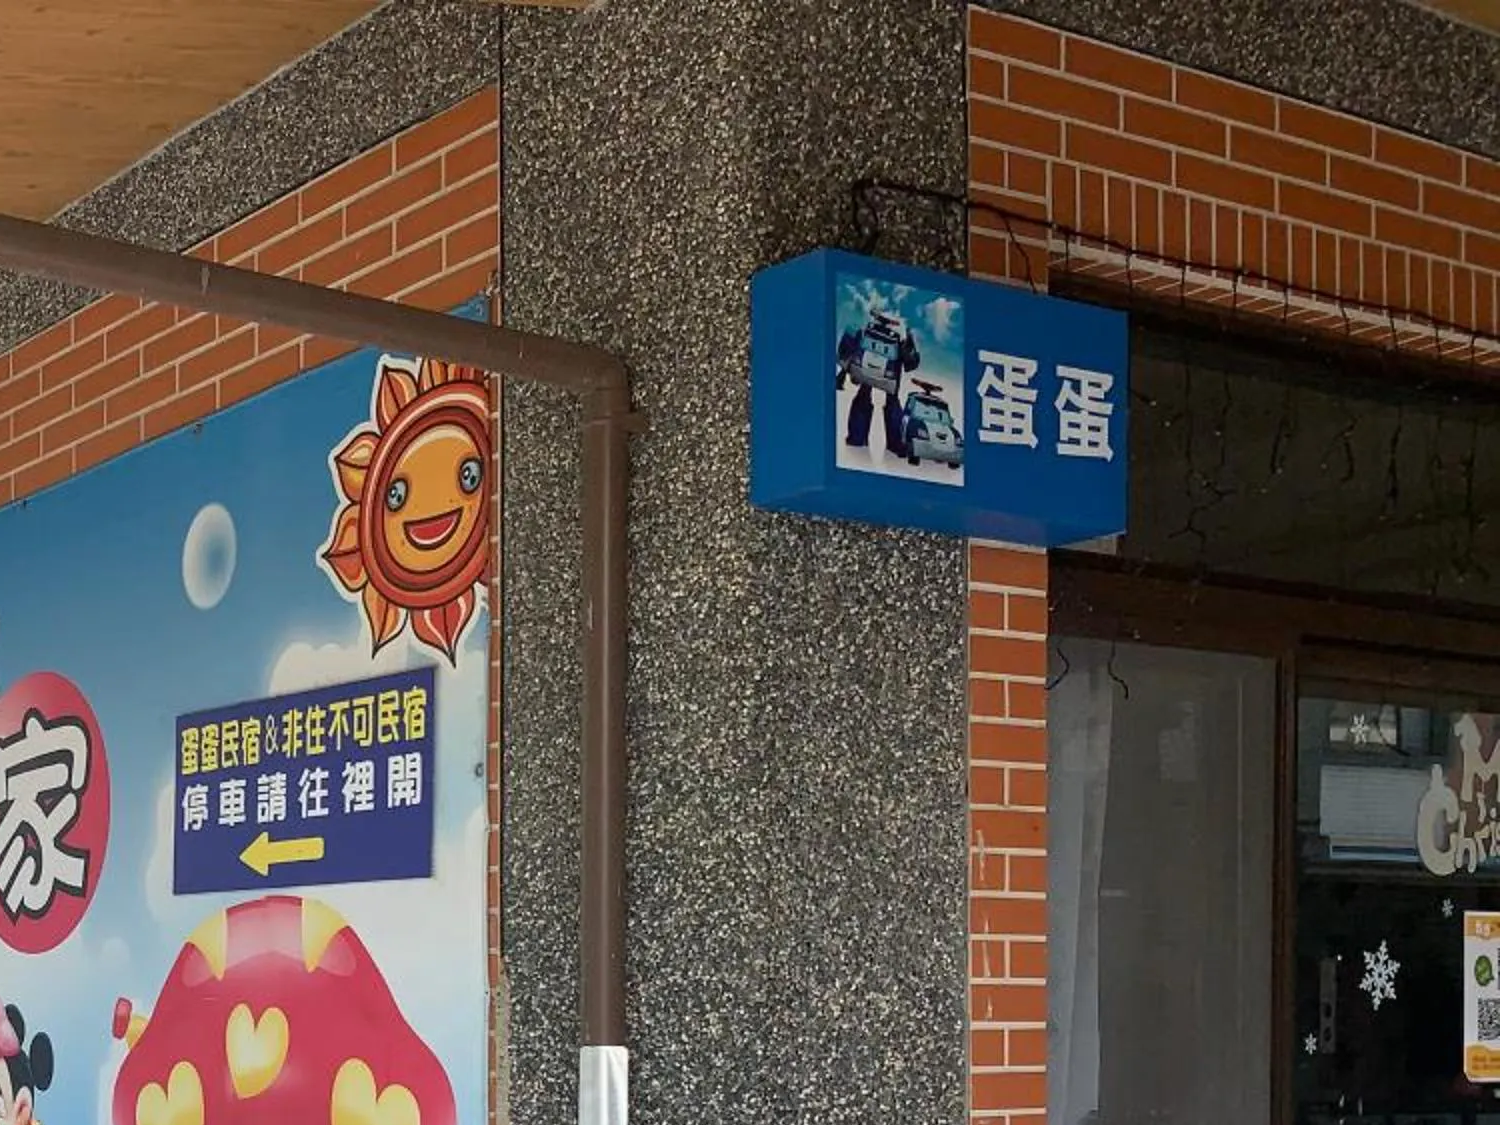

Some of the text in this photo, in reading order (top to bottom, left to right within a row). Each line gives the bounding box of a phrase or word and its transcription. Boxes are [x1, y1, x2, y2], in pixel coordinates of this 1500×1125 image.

[976, 348, 1115, 463] 蛋蛋
[182, 752, 423, 831] 停車請往裡開
